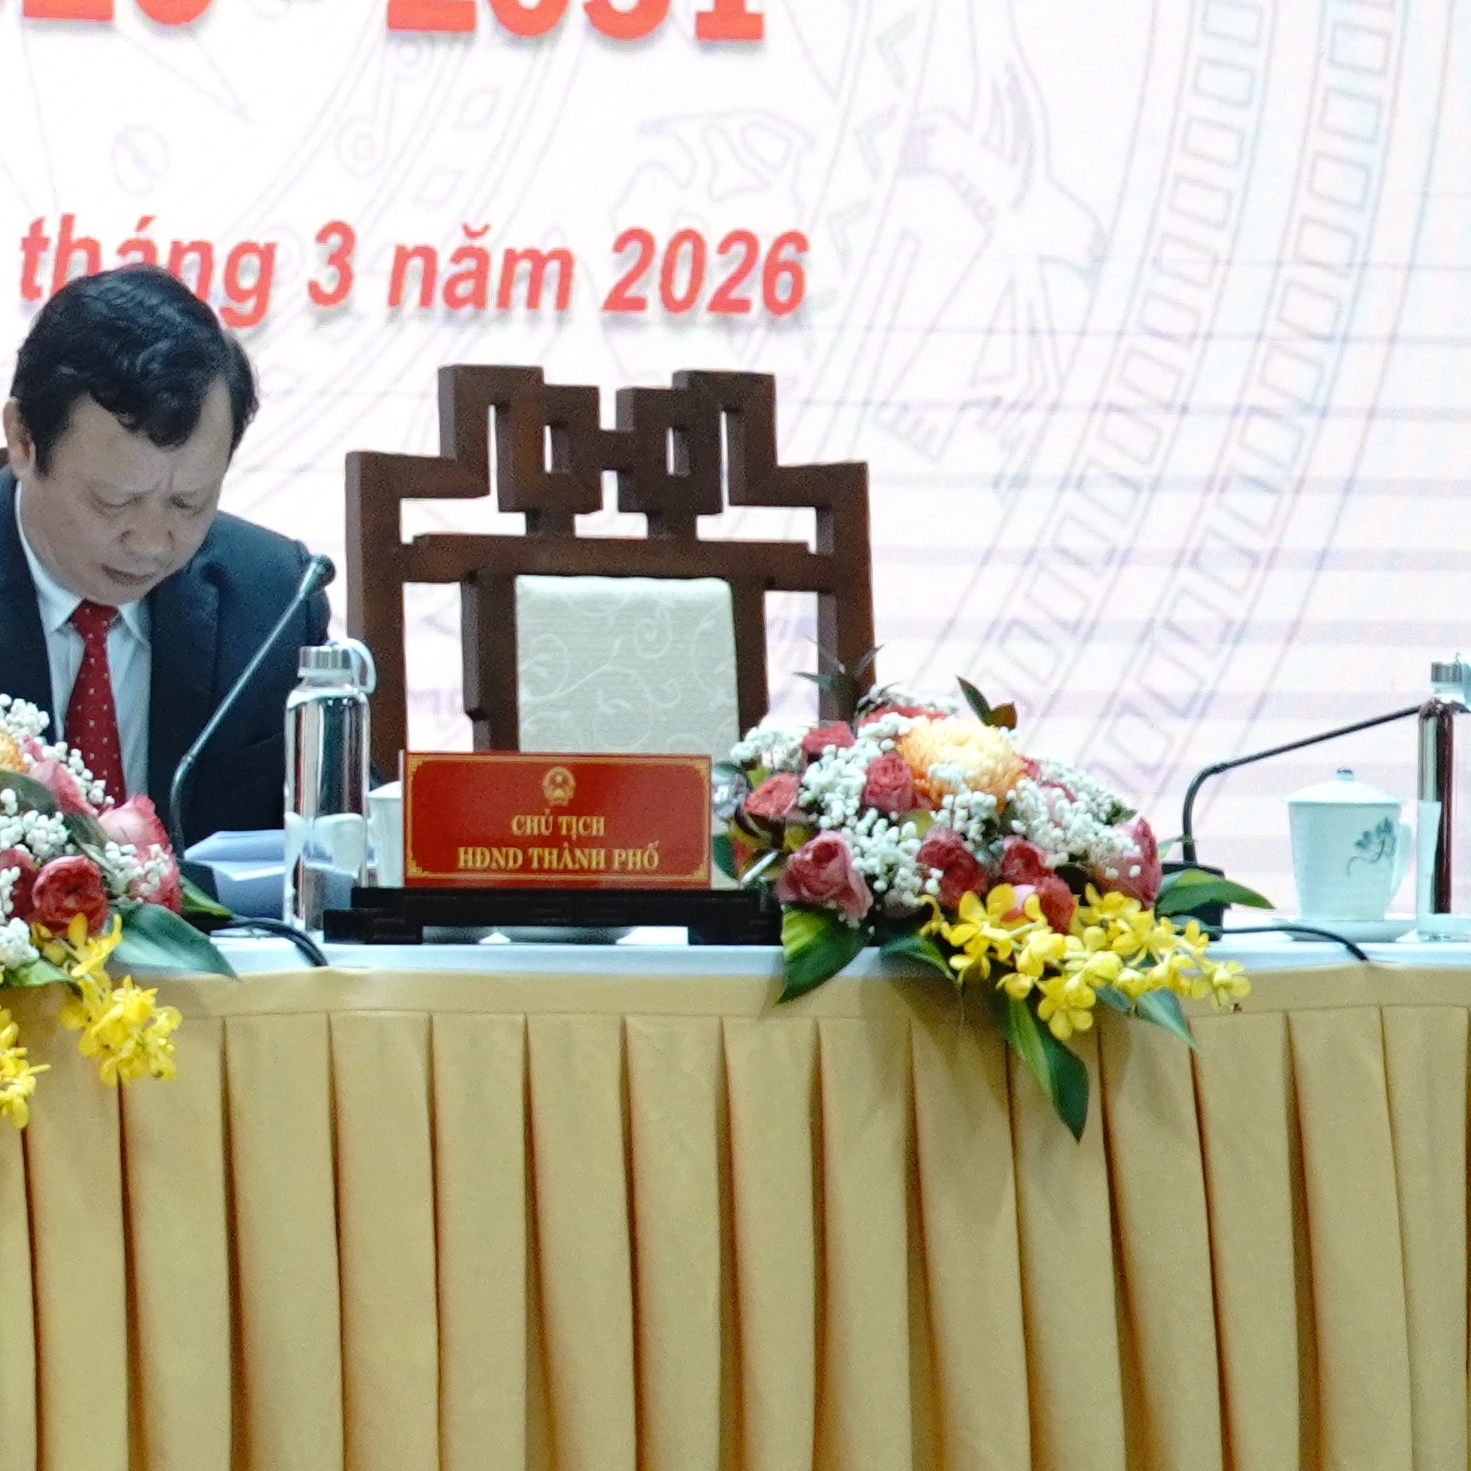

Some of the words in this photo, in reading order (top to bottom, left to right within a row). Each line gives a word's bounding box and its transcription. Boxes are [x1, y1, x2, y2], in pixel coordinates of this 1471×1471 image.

[307, 220, 356, 307] 3
[388, 224, 574, 311] năm
[602, 228, 809, 317] 2026
[511, 808, 554, 836] CHỦ
[558, 815, 605, 840] TỊCH
[457, 846, 523, 869] HĐND
[529, 842, 606, 870] THÀNH
[613, 840, 660, 870] PHỐ
